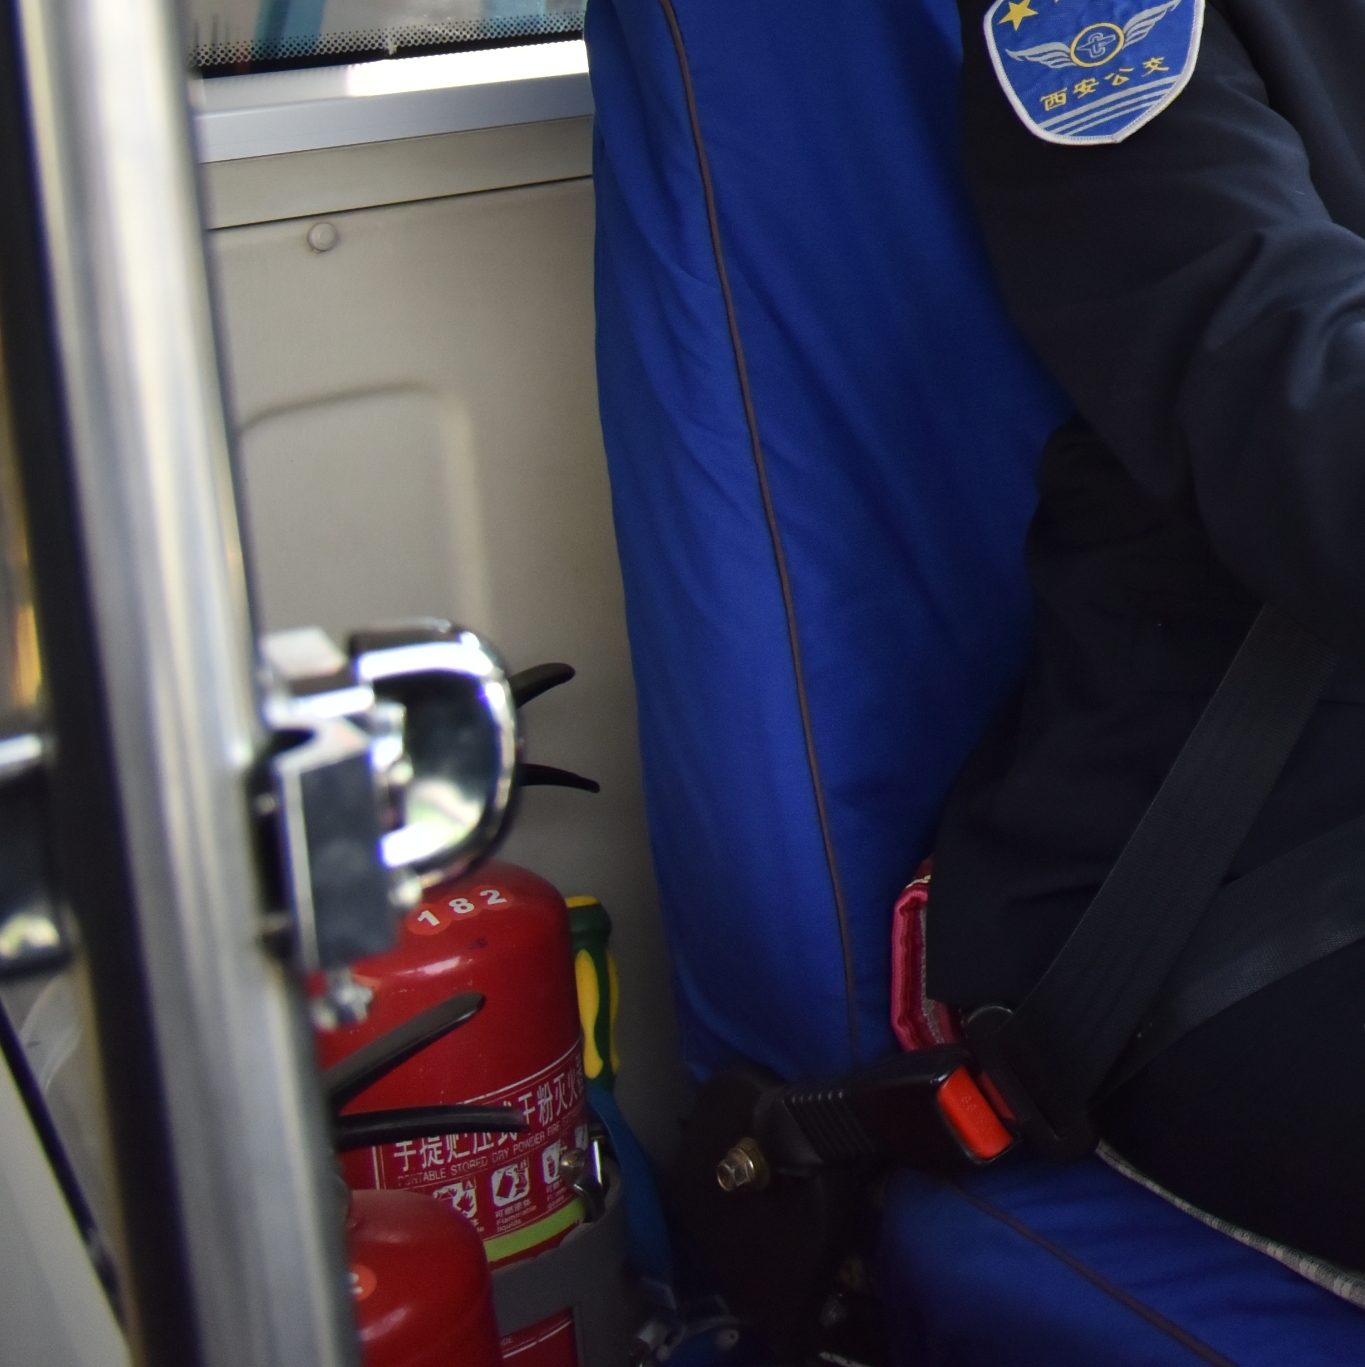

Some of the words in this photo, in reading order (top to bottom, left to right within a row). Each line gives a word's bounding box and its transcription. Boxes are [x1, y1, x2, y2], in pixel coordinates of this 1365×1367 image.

[1039, 55, 1171, 112] 西安公交
[417, 889, 508, 927] 182
